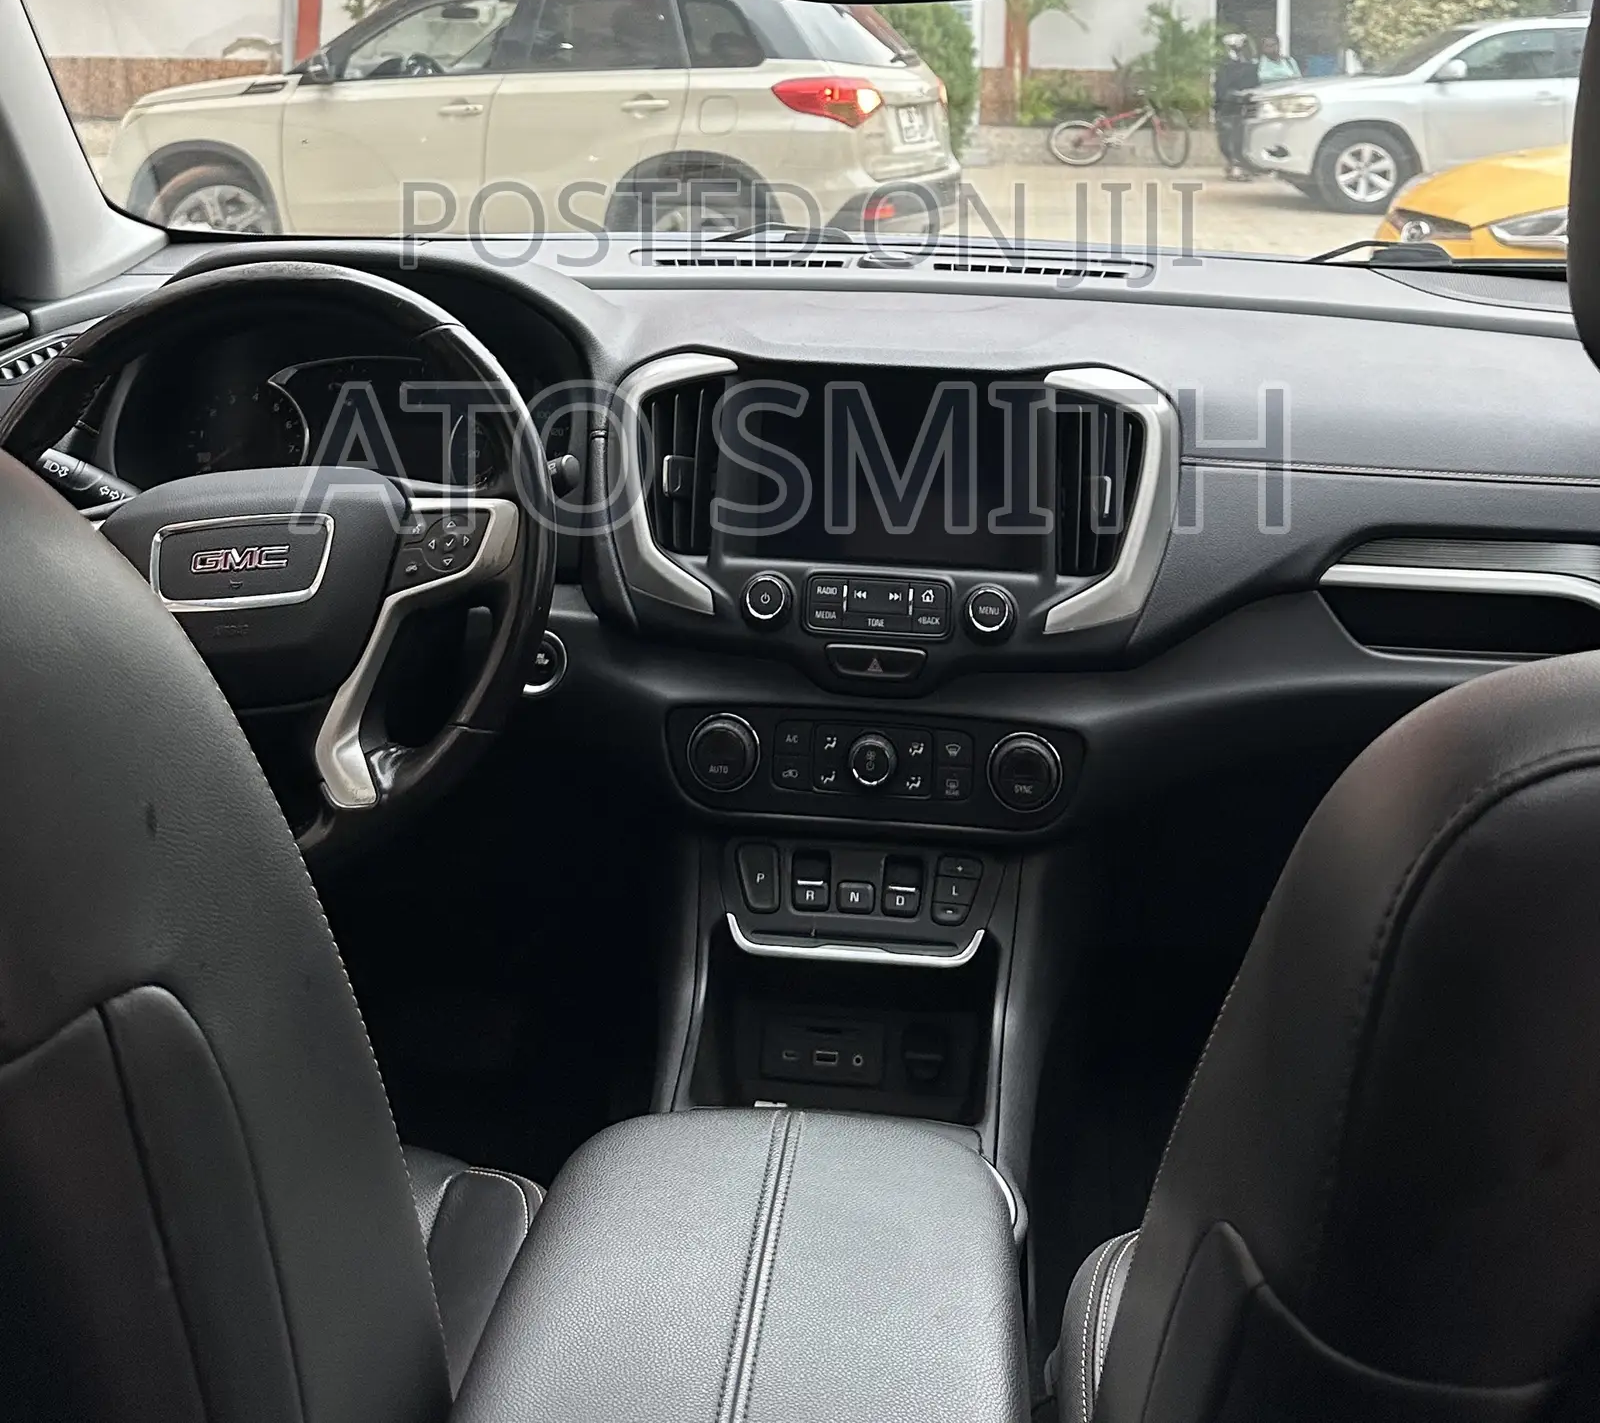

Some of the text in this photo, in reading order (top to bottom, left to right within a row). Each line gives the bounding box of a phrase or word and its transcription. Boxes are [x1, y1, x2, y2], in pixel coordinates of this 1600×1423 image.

[191, 545, 290, 573] GMC
[816, 585, 838, 595] RADIO
[815, 610, 837, 620] MEDIA
[978, 606, 1000, 616] MENU
[867, 618, 885, 628] TONE
[922, 616, 941, 626] BACK
[785, 734, 799, 743] A/C
[708, 765, 729, 774] AUTO
[1014, 784, 1033, 794] SYNC
[756, 872, 765, 883] P
[952, 885, 958, 896] L
[805, 890, 905, 906] R N D
